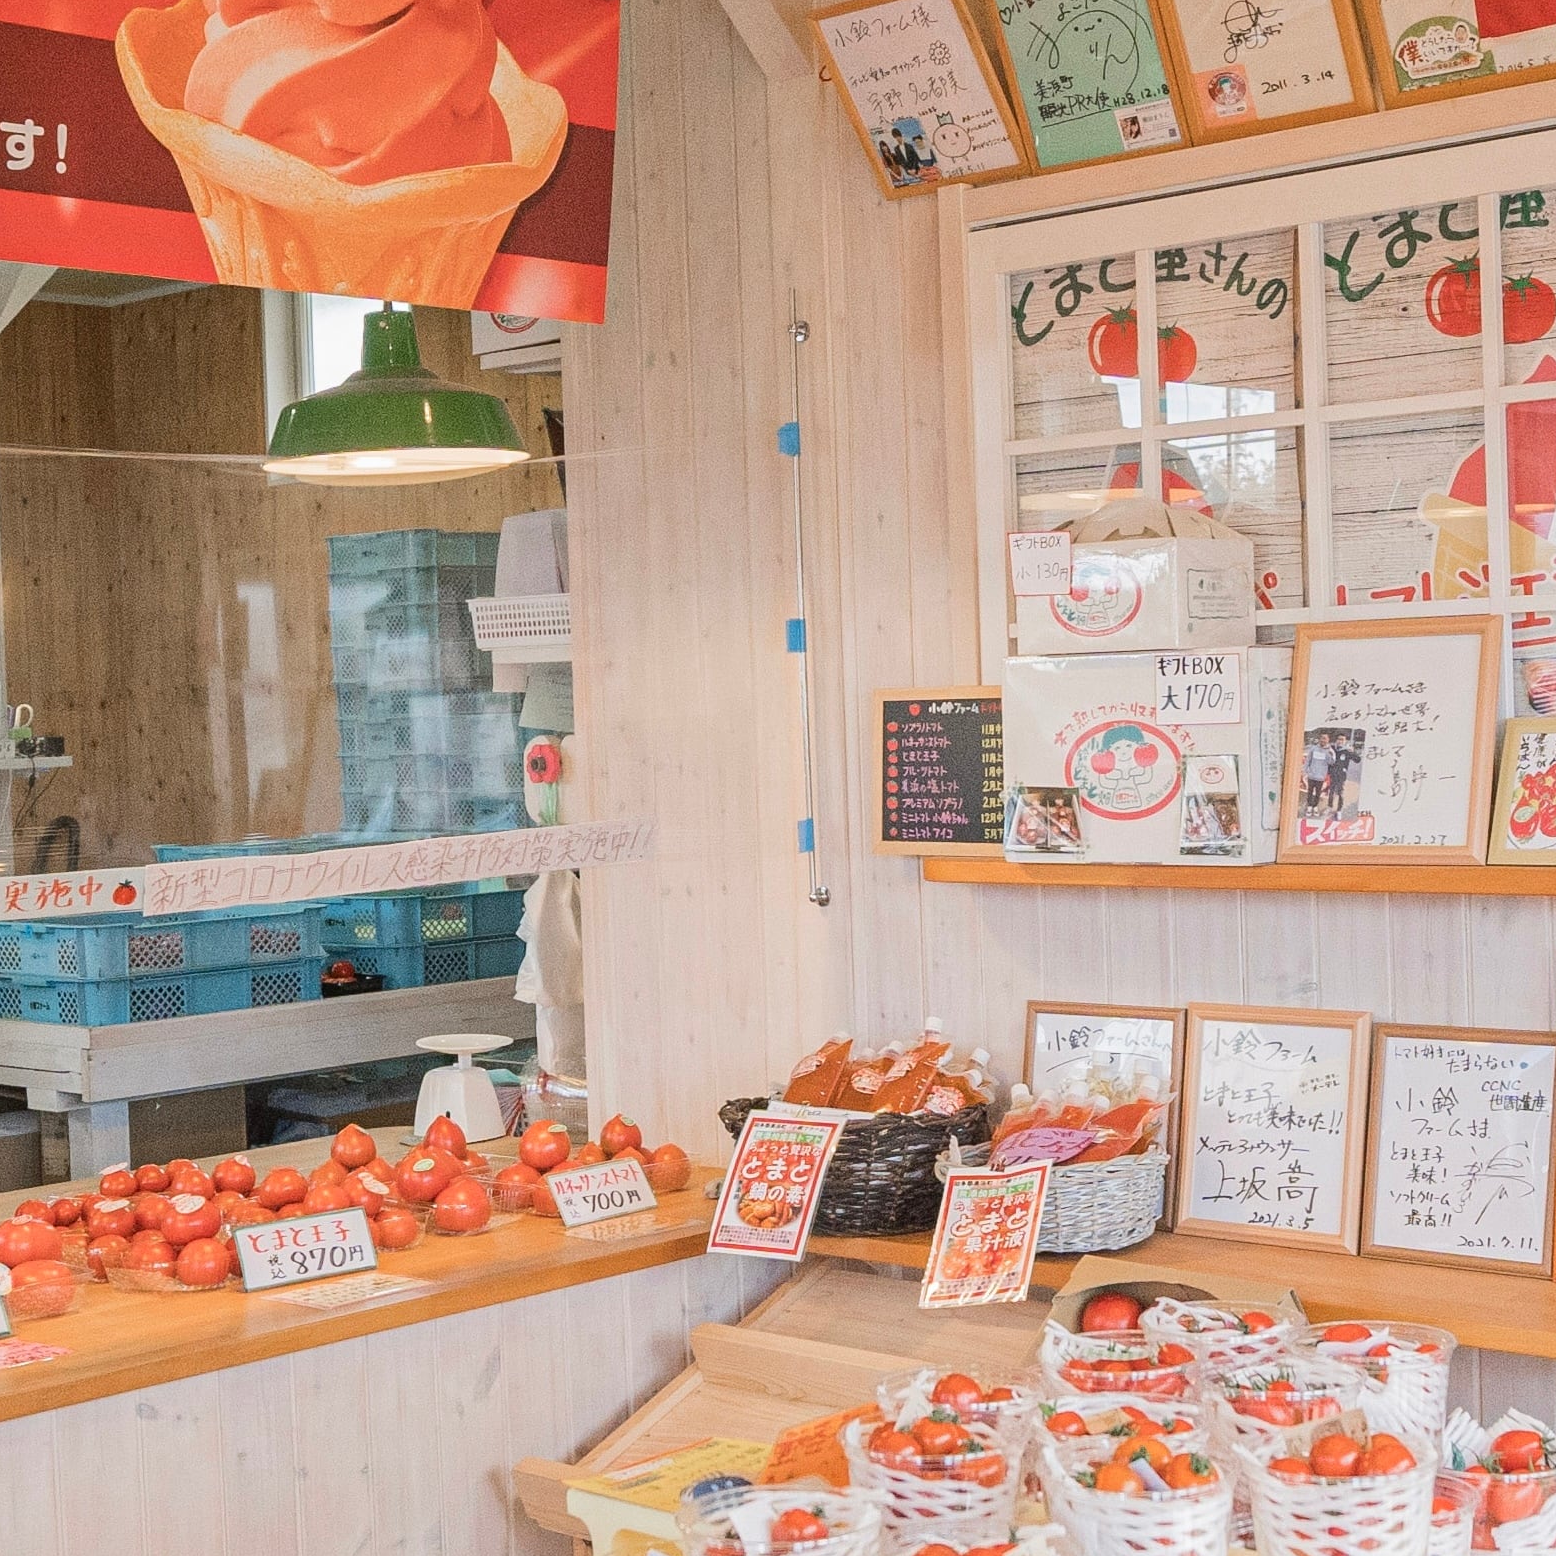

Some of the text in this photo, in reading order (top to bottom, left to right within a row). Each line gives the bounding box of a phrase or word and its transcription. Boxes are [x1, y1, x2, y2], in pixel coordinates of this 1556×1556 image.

[1156, 655, 1225, 679] ギフトBOX
[742, 1155, 812, 1183] とまと
[582, 1187, 643, 1215] 700円
[246, 1219, 351, 1254] とまと王子
[949, 1207, 1030, 1239] とまと
[289, 1244, 365, 1277] 870円
